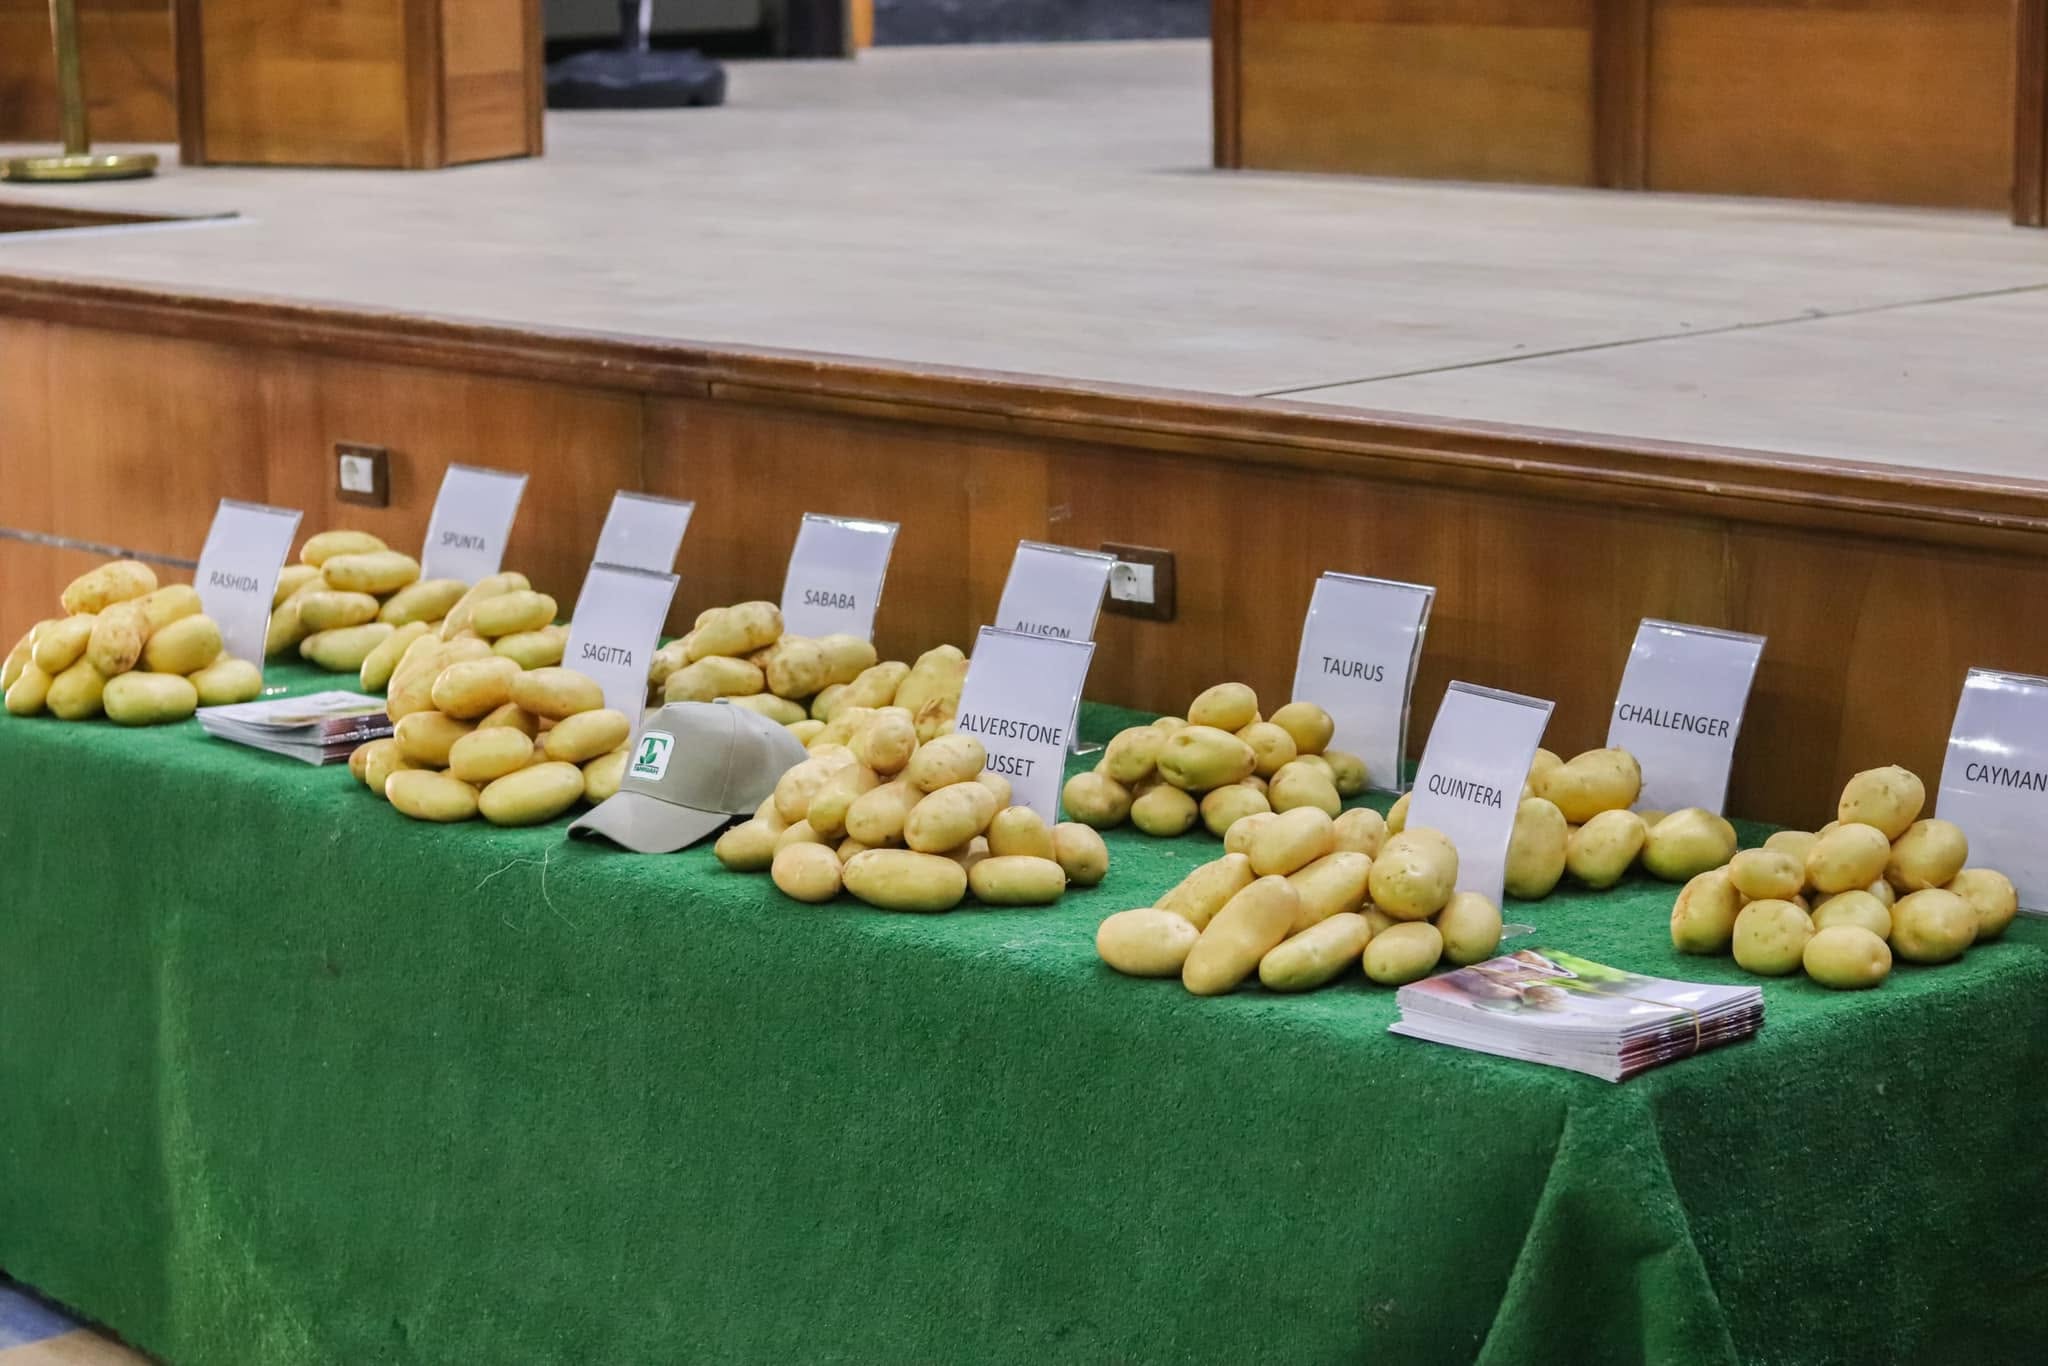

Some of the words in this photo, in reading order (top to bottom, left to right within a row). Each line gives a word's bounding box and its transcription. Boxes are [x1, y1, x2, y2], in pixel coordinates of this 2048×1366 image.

[441, 531, 485, 552] SPUNTA
[209, 570, 259, 592] RASHIDA
[803, 589, 856, 610] SABABA
[581, 642, 632, 667] SAGITTA
[1322, 656, 1384, 682] TAURUS
[959, 713, 1063, 746] ALVERSTONE
[1619, 703, 1730, 738] CHALLENGER
[986, 753, 1035, 777] USSET
[1965, 762, 2048, 792] CAYMAN
[1428, 774, 1502, 809] QUINTERA
